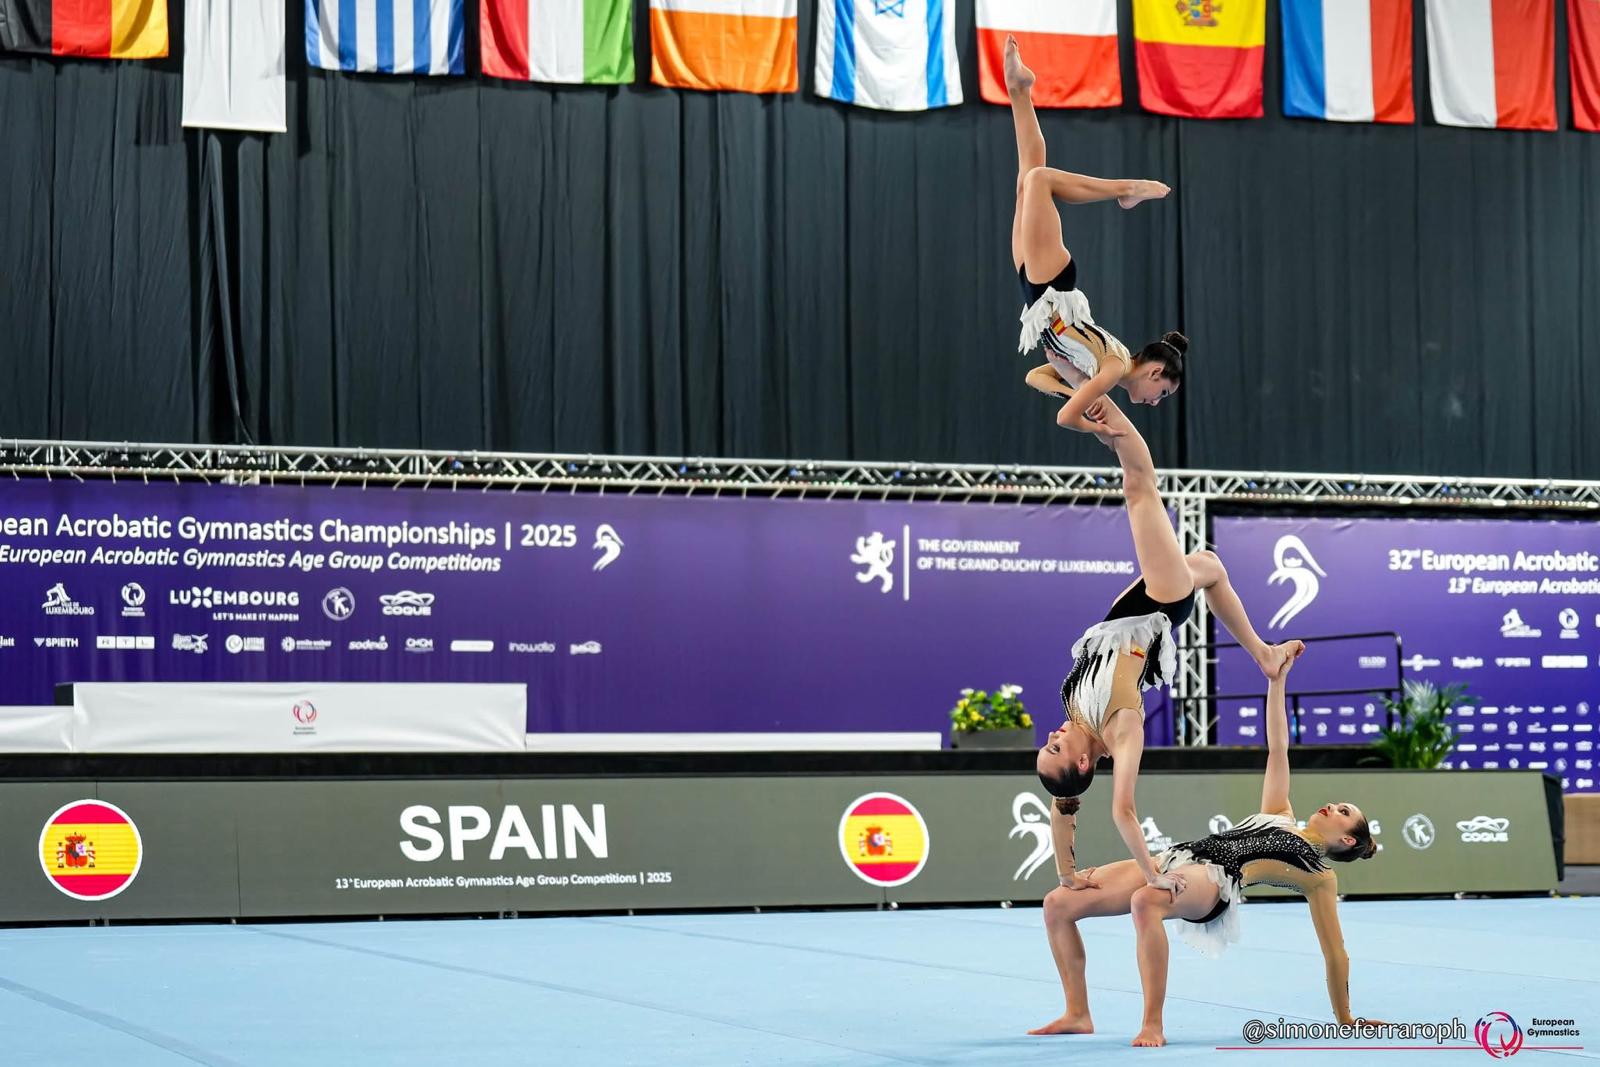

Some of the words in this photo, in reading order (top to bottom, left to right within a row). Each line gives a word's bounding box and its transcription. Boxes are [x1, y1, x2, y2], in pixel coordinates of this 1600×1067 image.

[0, 517, 48, 537] ean
[55, 513, 172, 538] Acrobatic
[178, 516, 314, 544] Gymnastics
[319, 518, 496, 550] Championships
[520, 523, 577, 547] 2025
[918, 538, 940, 552] THE
[941, 539, 1021, 553] GOVERNMENT
[0, 544, 86, 567] European
[90, 546, 179, 566] Acrobatic
[183, 548, 285, 569] Gymnastics
[288, 550, 325, 571] Age
[328, 551, 383, 573] Group
[387, 552, 501, 574] Competitions
[917, 556, 933, 570] OF
[935, 557, 957, 571] THE
[958, 557, 1041, 572] GRAND-DUCHY
[1041, 558, 1057, 572] OF
[1058, 560, 1134, 574] LUXEMBOURG
[1422, 549, 1509, 574] European
[1513, 550, 1599, 572] Acrobatic
[1472, 577, 1538, 597] European
[1539, 577, 1600, 594] Acrobati
[170, 586, 299, 608] LUXEMBOURG
[46, 606, 94, 616] LUXEMBOURG
[213, 612, 234, 620] LET'S
[235, 613, 257, 621] MAKE
[258, 613, 267, 621] IT
[268, 613, 299, 622] HAPPEN
[382, 606, 432, 616] COQUE
[45, 637, 79, 648] SPIETH
[399, 804, 608, 862] SPAIN
[1461, 832, 1509, 842] COQUE
[354, 877, 403, 890] European
[405, 875, 454, 888] Acrobatic
[456, 874, 514, 889] Gymnastics
[515, 874, 535, 888] Age
[537, 873, 569, 887] Group
[570, 872, 637, 886] Competitions
[647, 871, 672, 883] 2025
